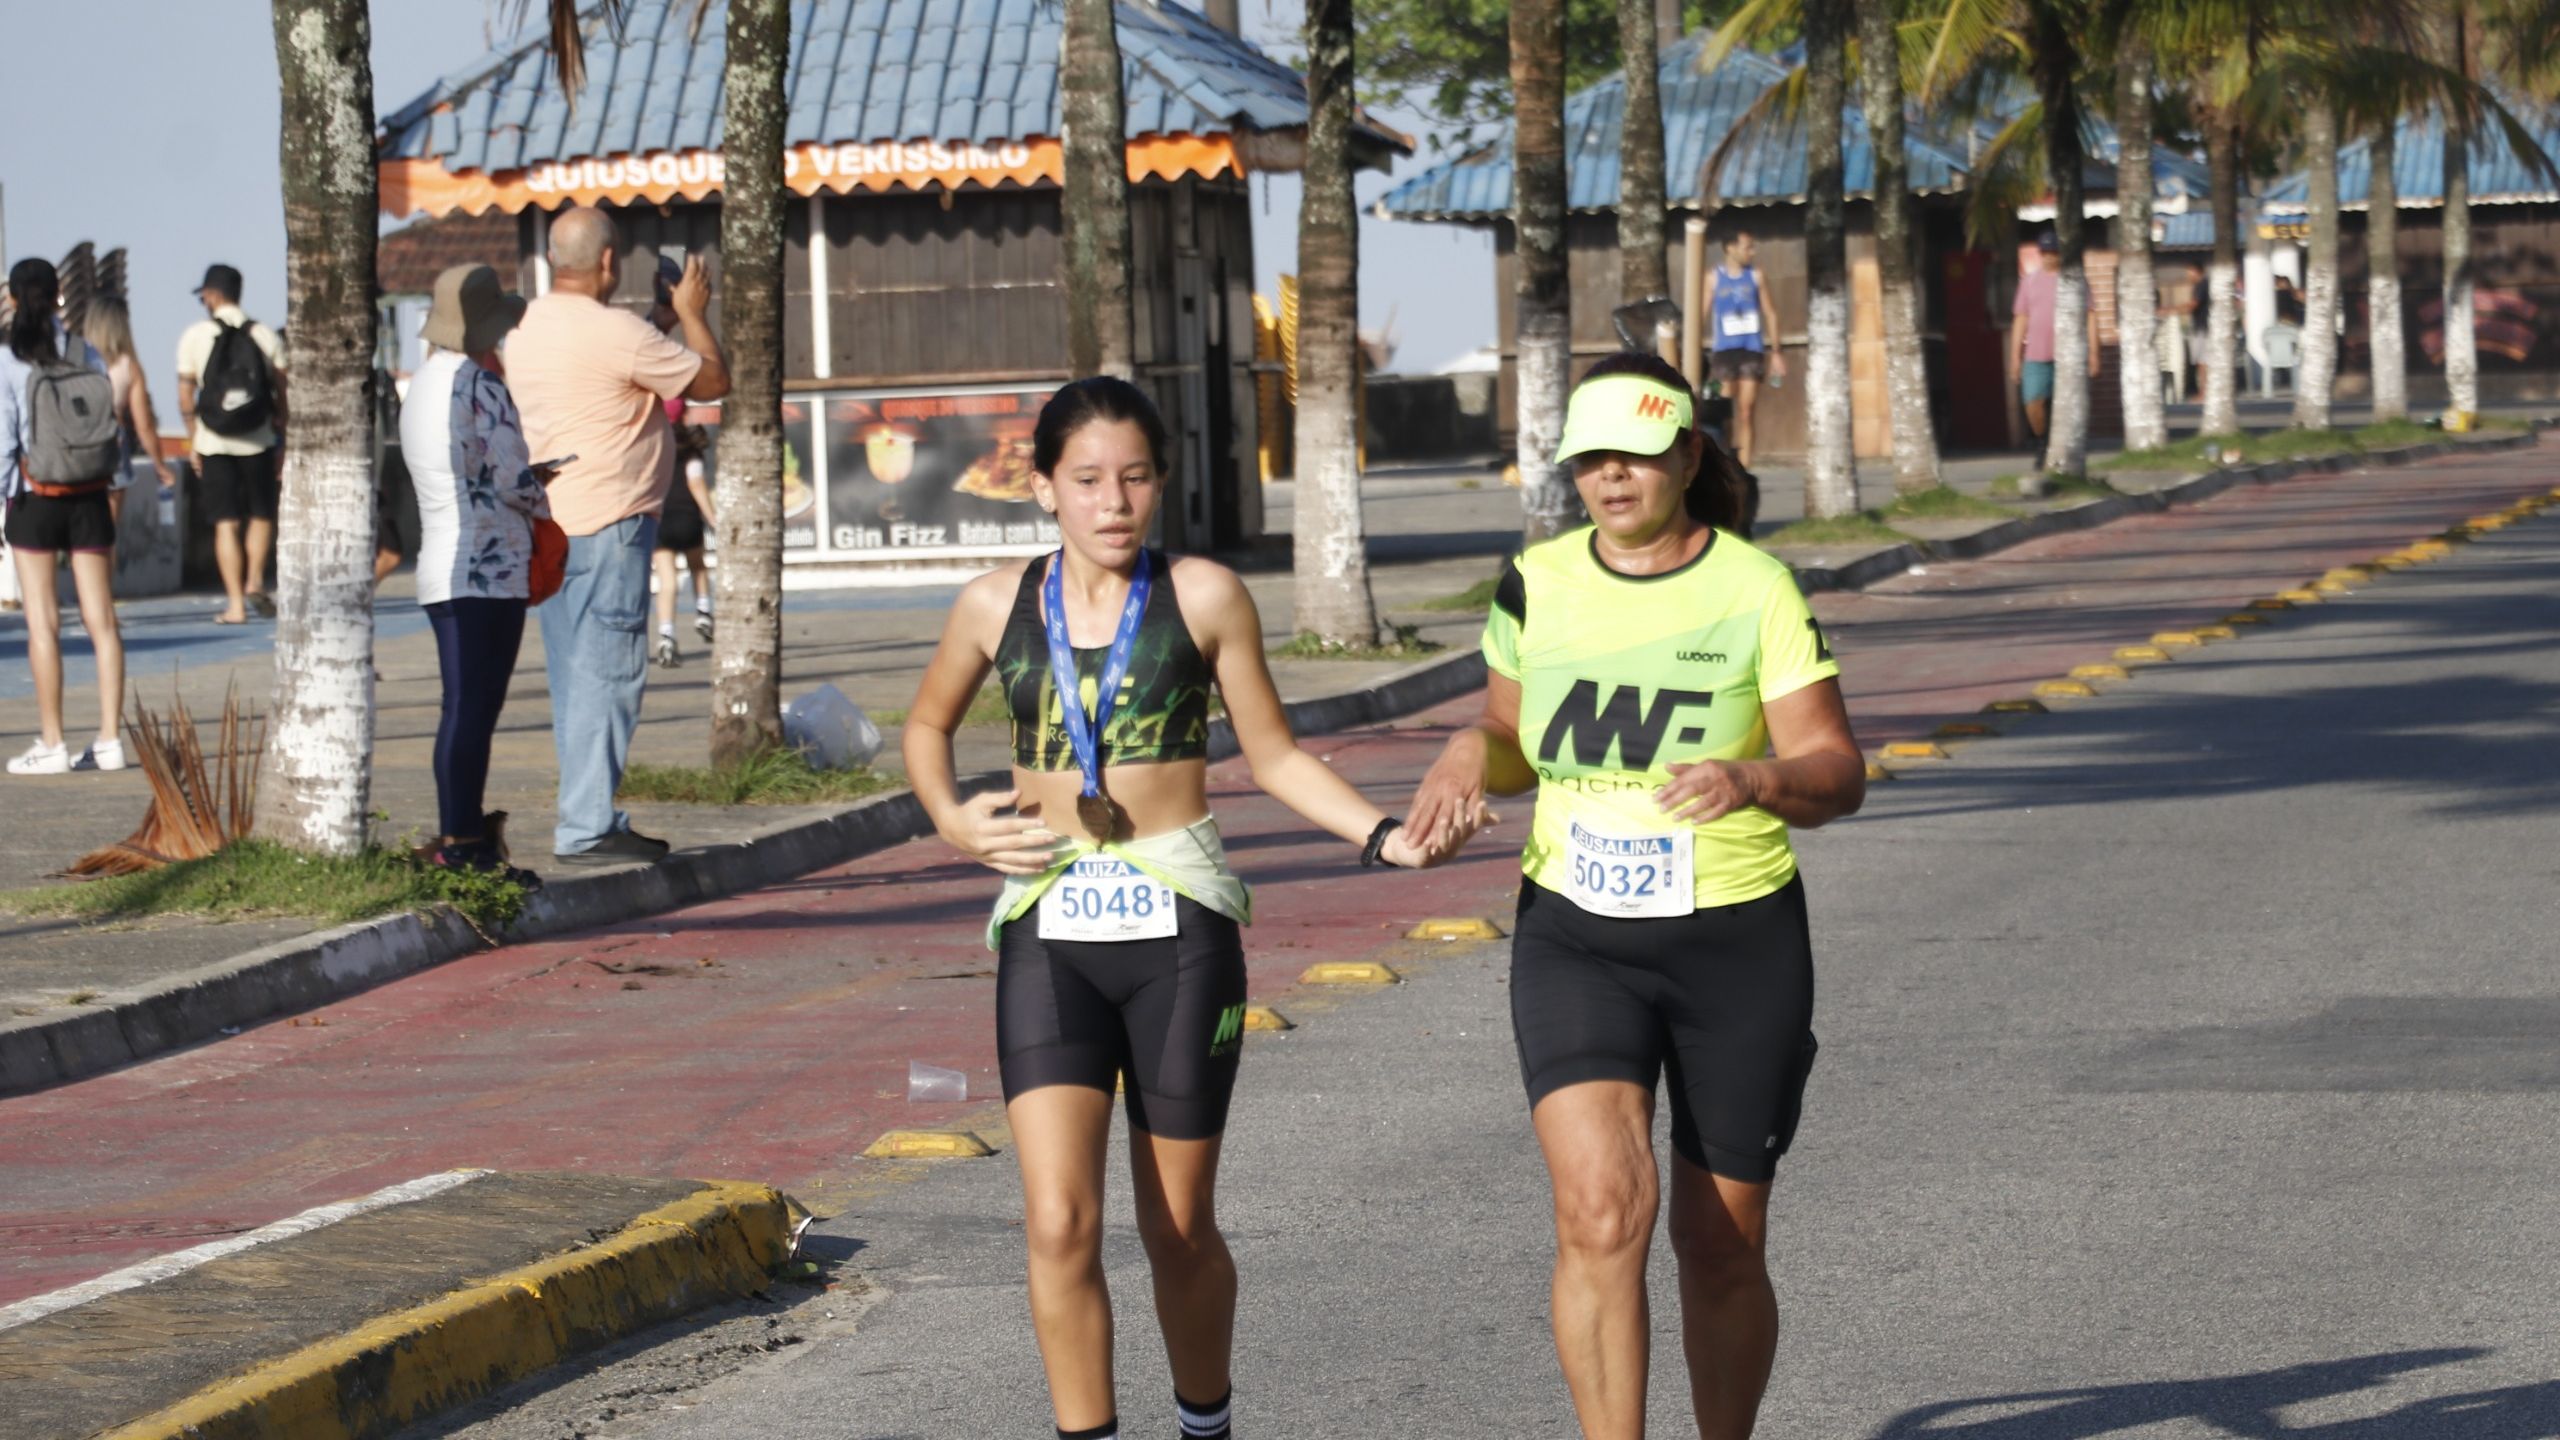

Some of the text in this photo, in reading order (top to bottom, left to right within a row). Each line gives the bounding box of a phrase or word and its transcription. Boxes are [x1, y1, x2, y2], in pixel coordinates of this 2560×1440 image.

[527, 150, 726, 193] QUIOSQUE
[808, 141, 1030, 177] VERISSIMO
[833, 525, 883, 549] Gin
[891, 520, 947, 546] Fizz
[1676, 651, 1727, 663] woom
[1573, 823, 1662, 856] DEUSALINA
[1073, 861, 1130, 878] LUIZA
[1574, 853, 1656, 898] 5032
[1061, 884, 1154, 920] 5048
